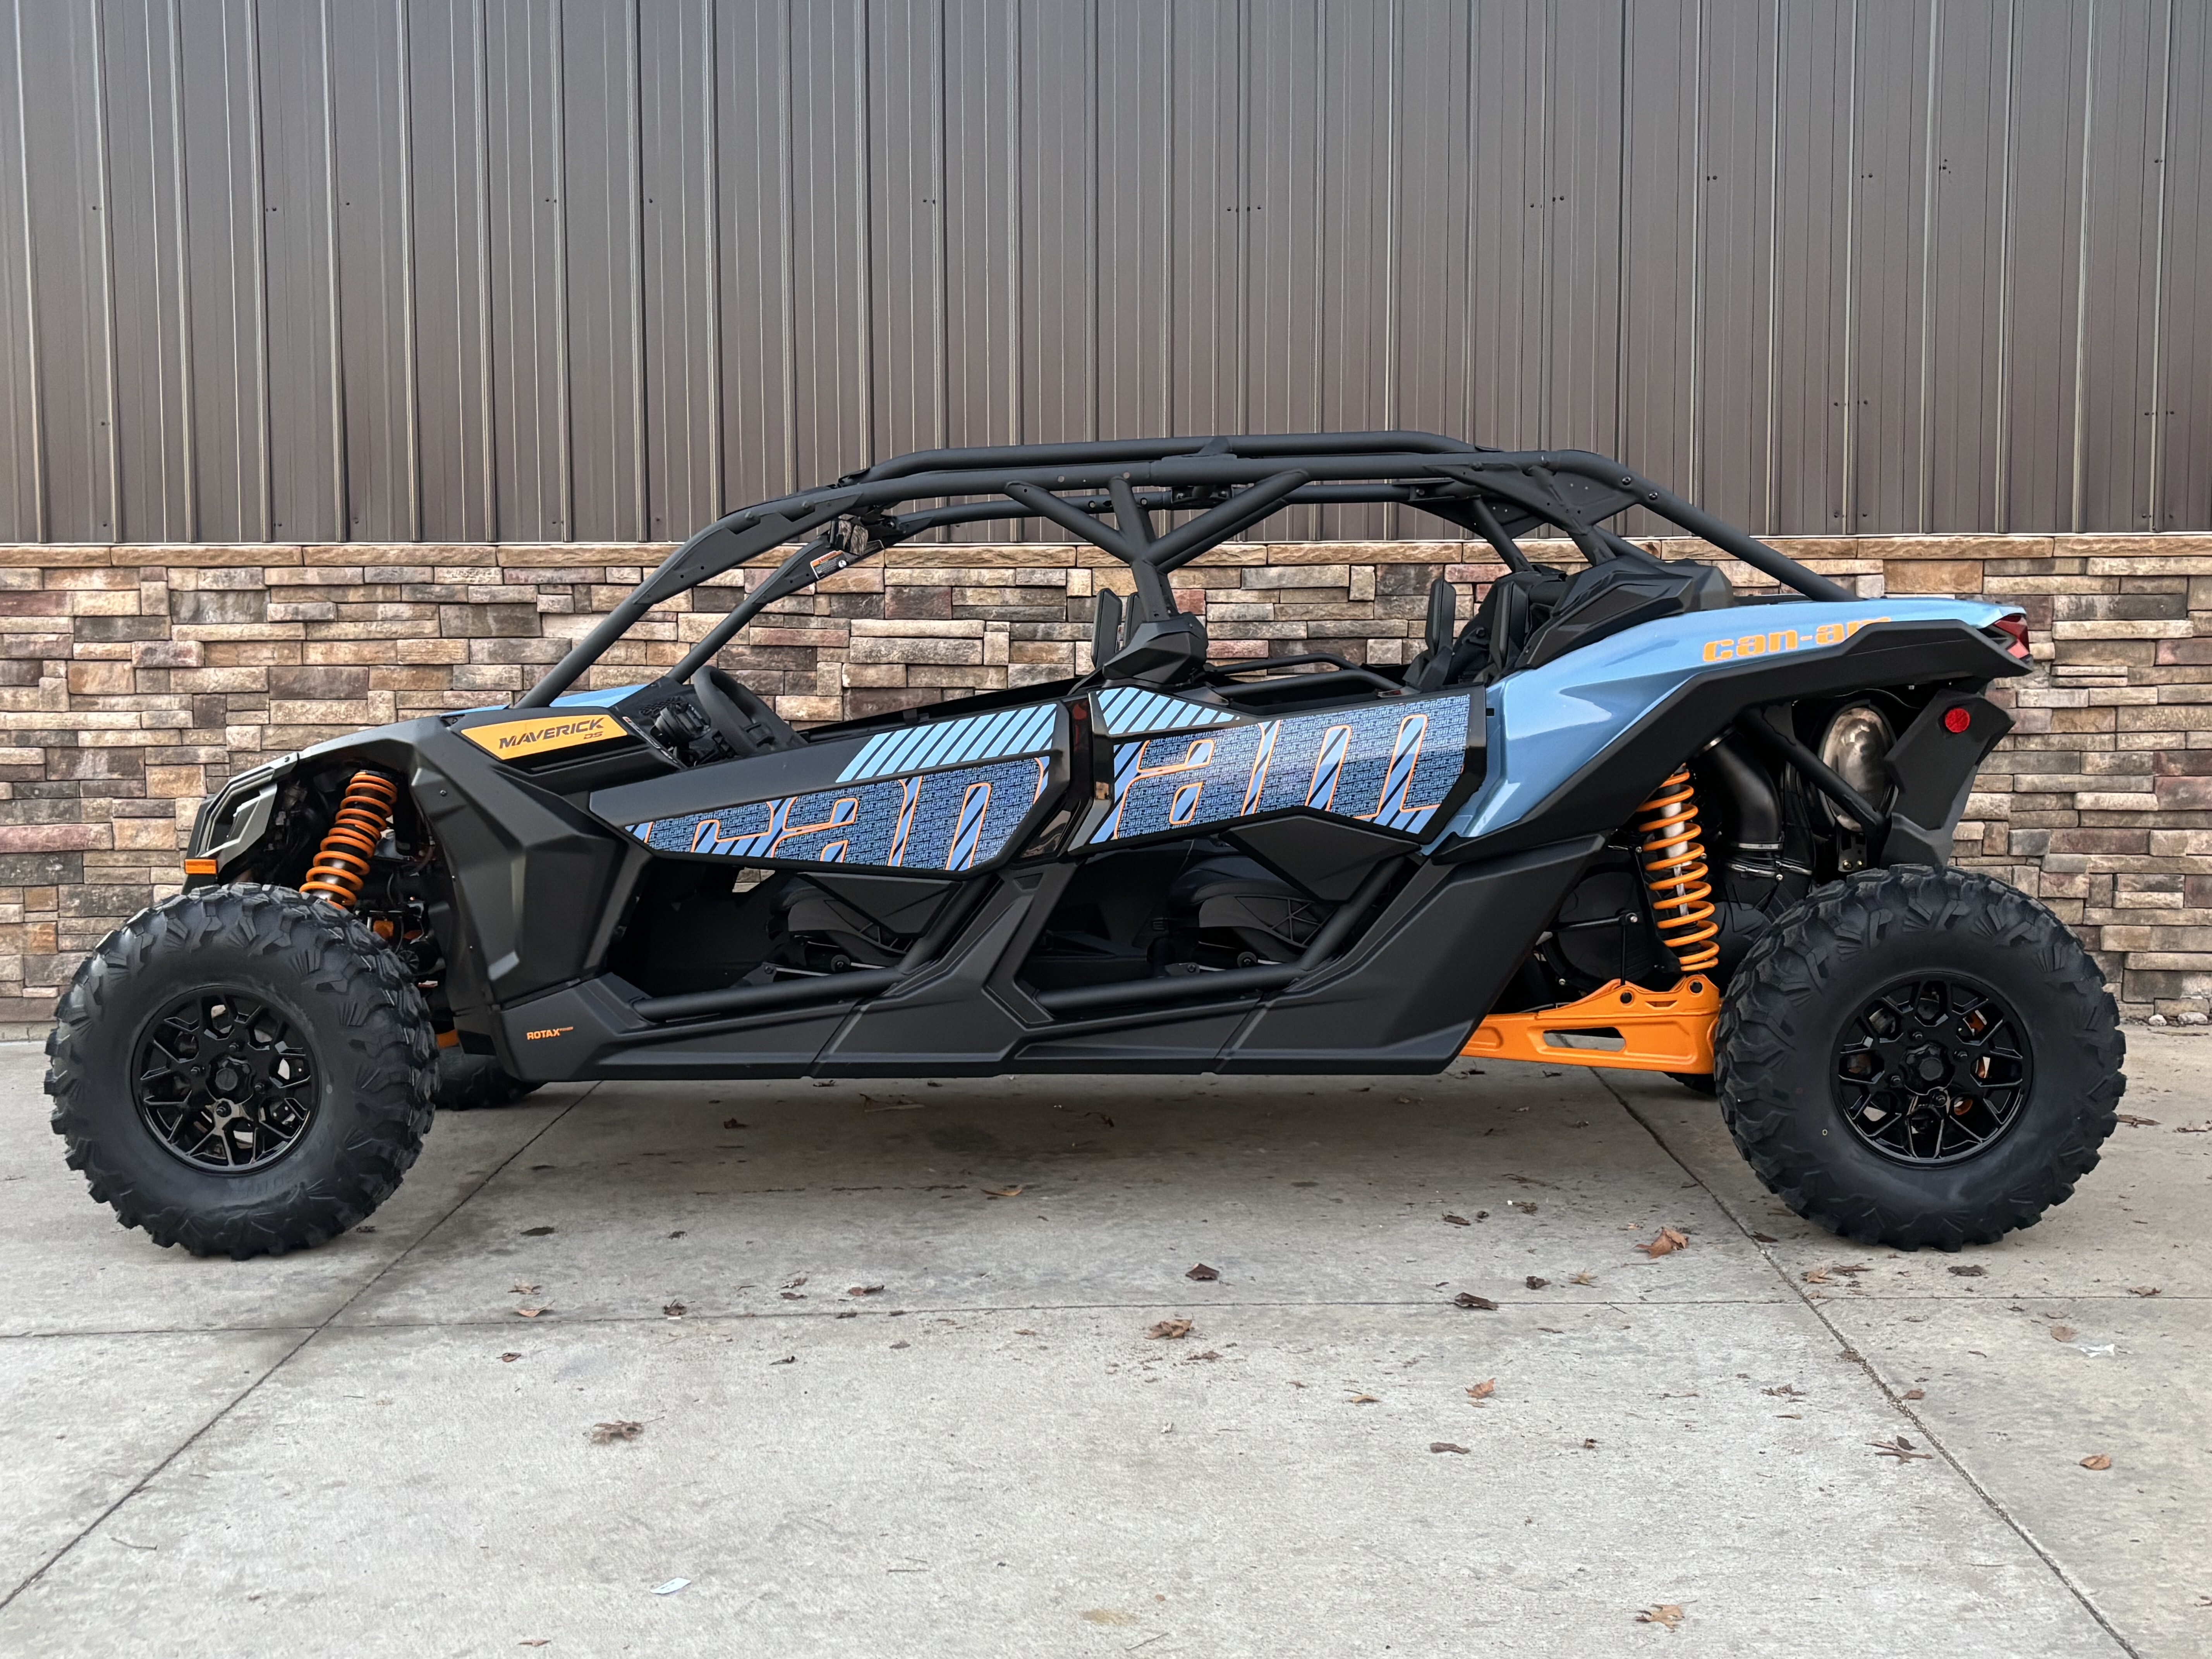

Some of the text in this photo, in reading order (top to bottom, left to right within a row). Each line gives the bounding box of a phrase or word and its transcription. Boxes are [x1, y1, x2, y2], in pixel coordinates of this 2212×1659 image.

[499, 717, 605, 749] MAVERICK
[583, 731, 603, 740] DS
[527, 1029, 560, 1040] ROTAX
